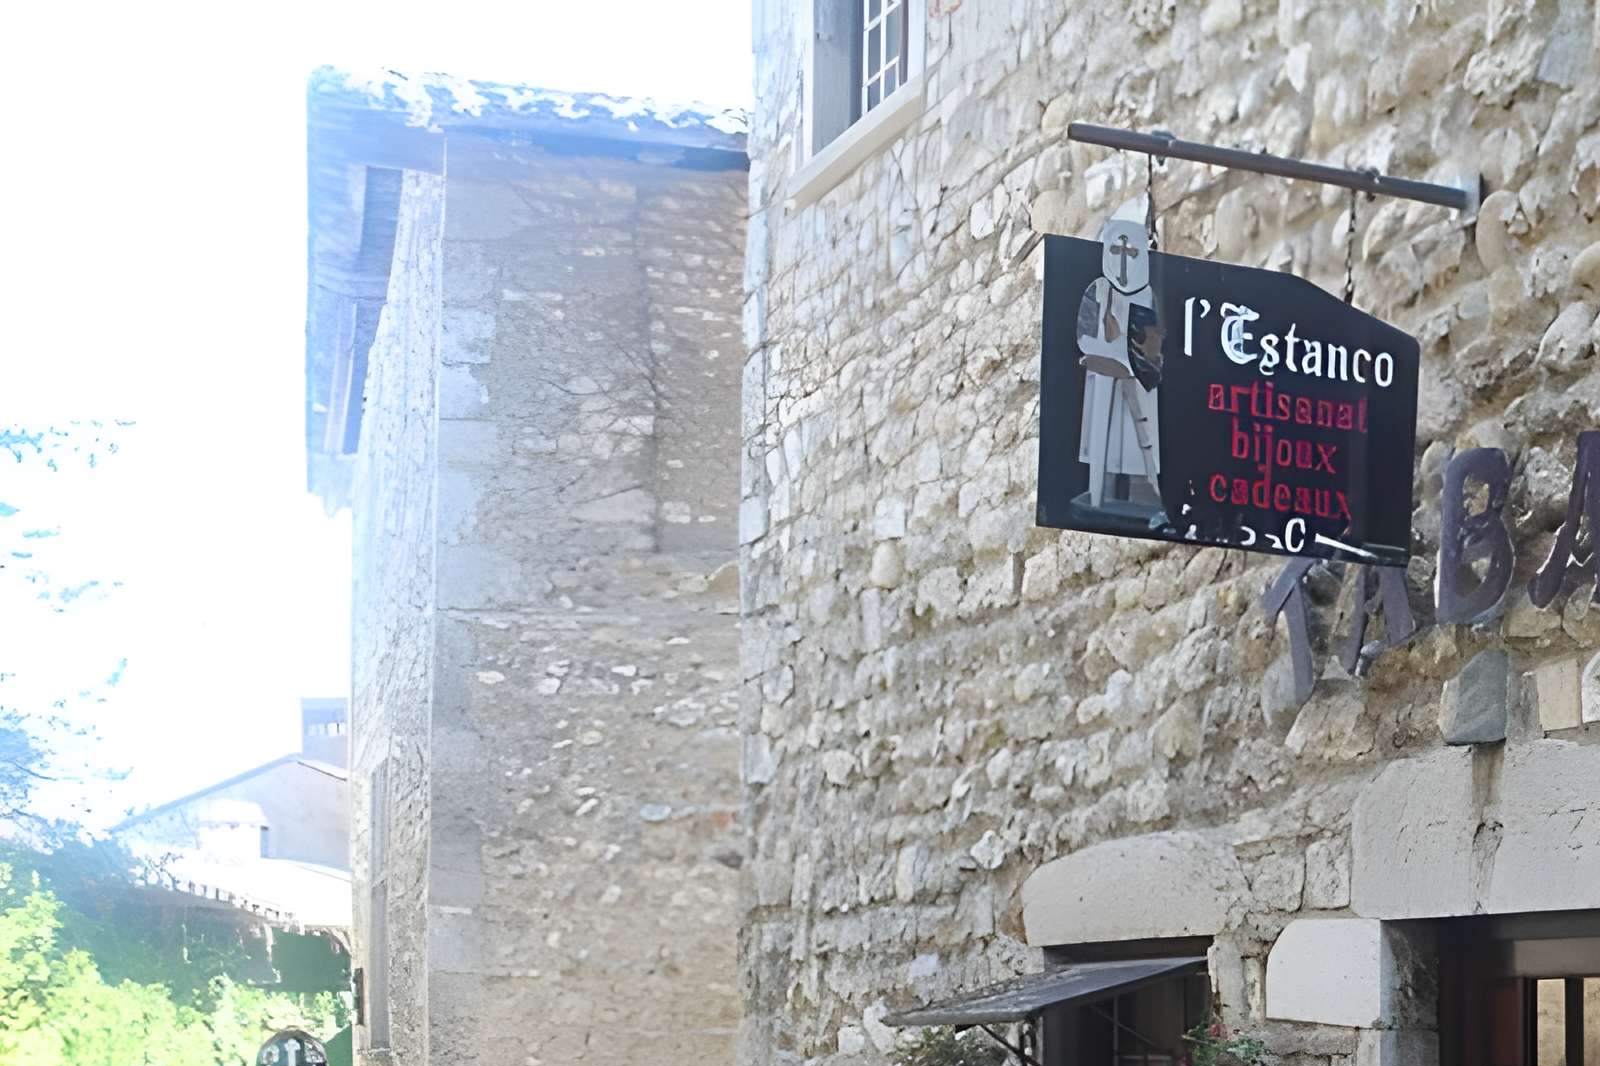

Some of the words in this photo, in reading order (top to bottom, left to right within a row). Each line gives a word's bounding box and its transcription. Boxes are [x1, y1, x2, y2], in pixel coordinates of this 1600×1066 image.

[1183, 296, 1395, 388] l'Estanco
[1206, 380, 1369, 434] artisanal
[1230, 415, 1338, 475] bijoux
[1207, 470, 1352, 522] cadeaux
